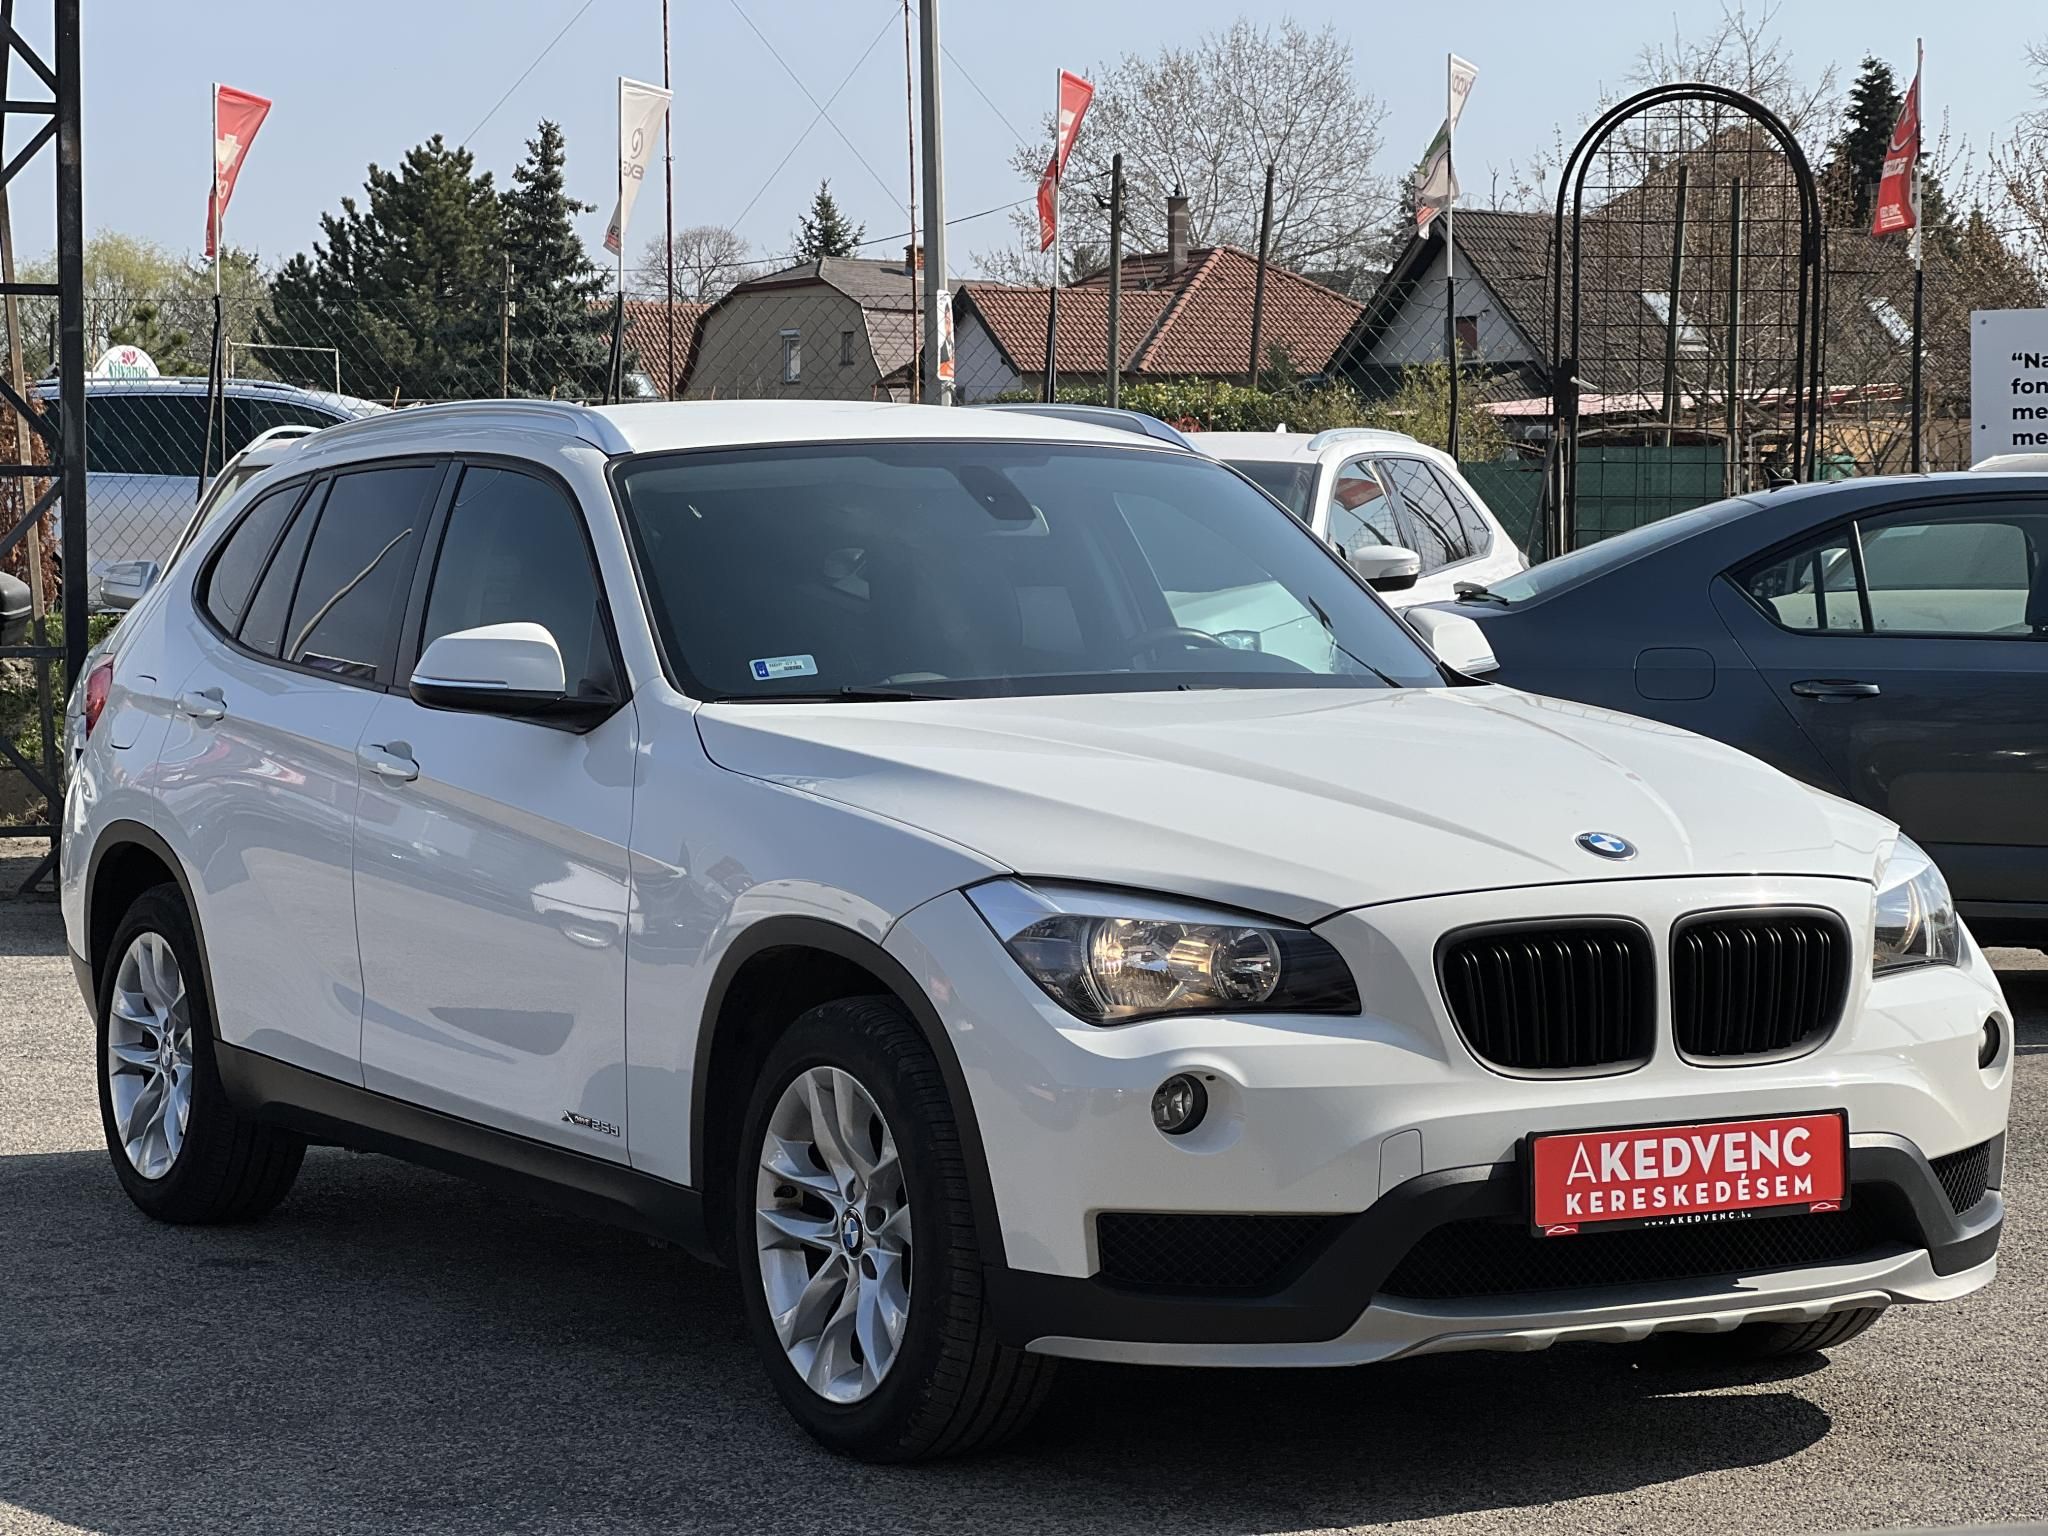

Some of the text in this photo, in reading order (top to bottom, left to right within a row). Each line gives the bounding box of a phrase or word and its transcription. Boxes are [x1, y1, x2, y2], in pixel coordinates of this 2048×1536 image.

[2012, 406, 2048, 420] me
[2012, 432, 2048, 446] me
[1566, 1173, 1813, 1216] KERESKEDÉSEM
